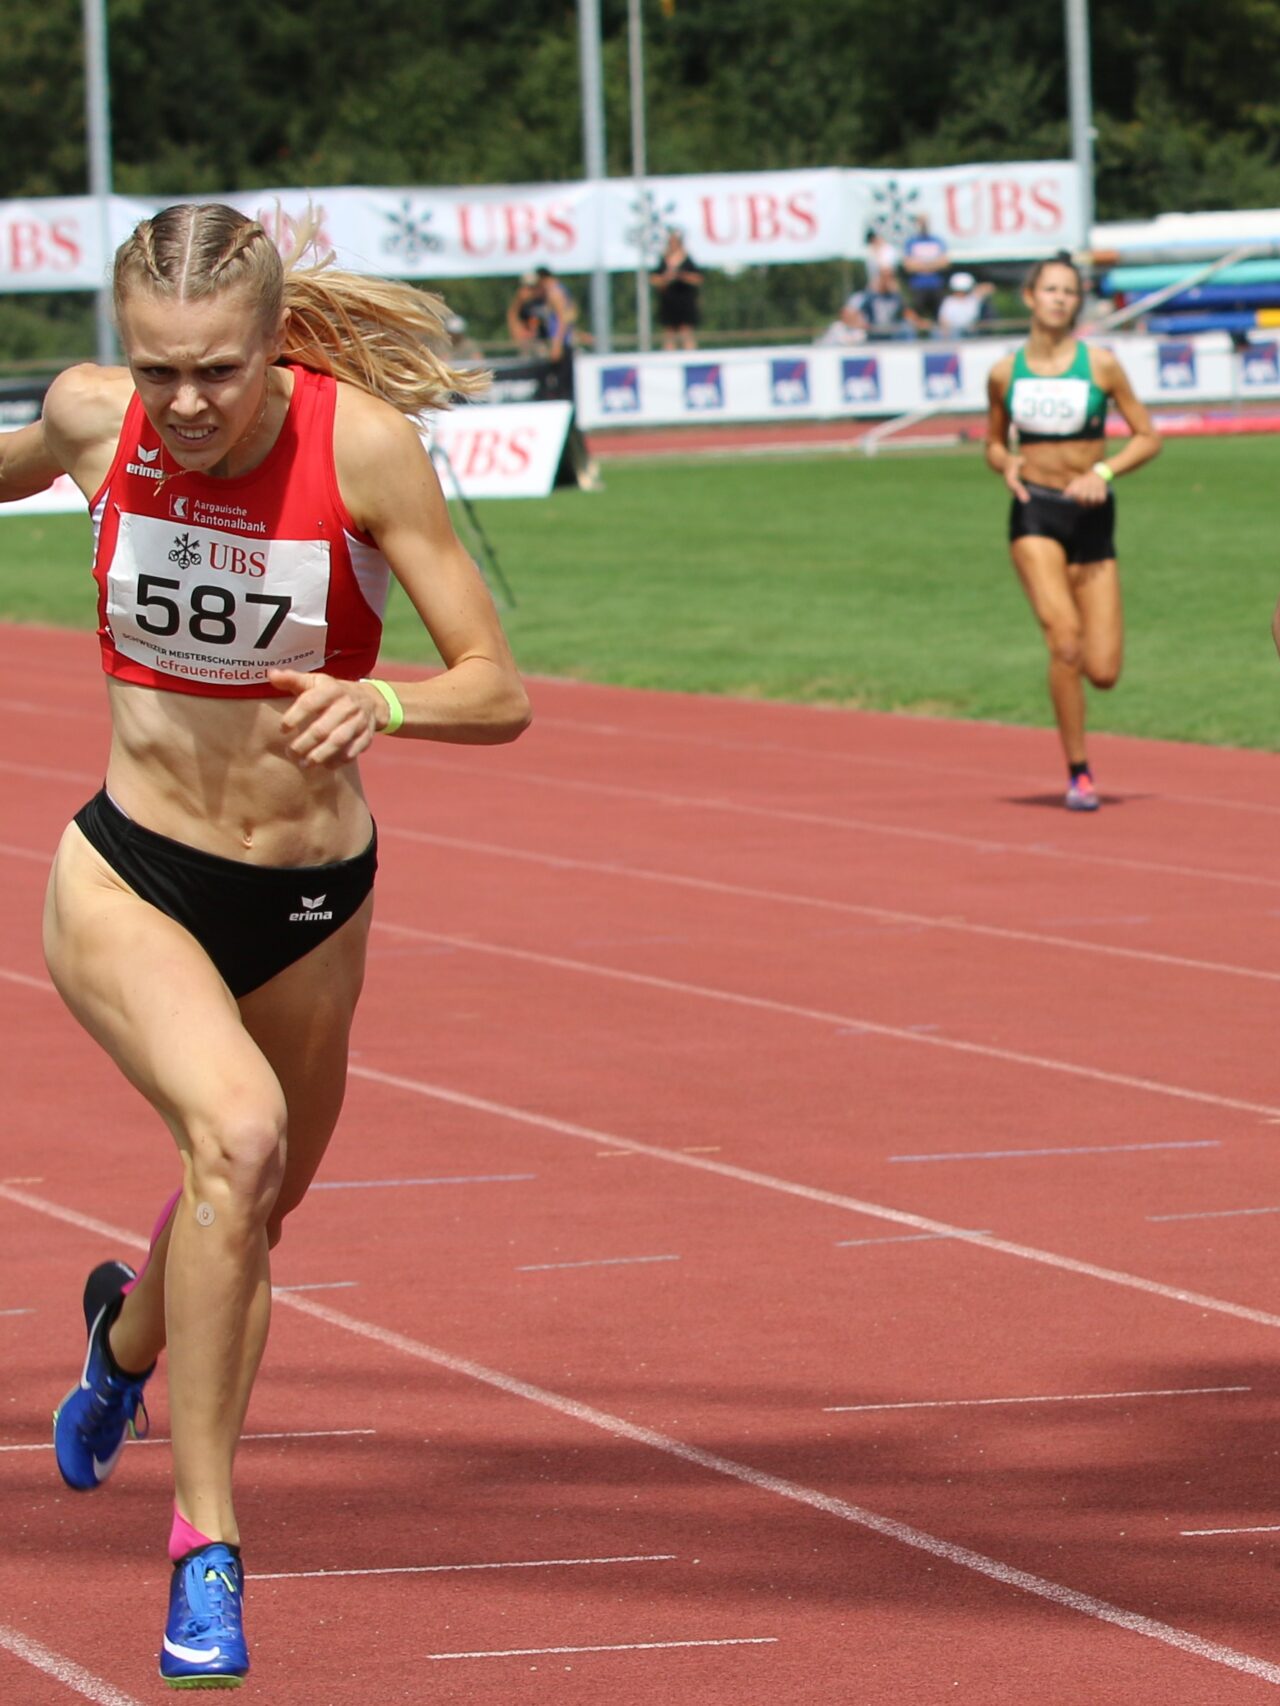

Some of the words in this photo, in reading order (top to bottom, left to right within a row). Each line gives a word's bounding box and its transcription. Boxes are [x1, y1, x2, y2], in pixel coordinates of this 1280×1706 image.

[702, 190, 818, 245] UBS
[944, 179, 1064, 239] UBS
[457, 203, 577, 257] UBS
[9, 217, 83, 274] BS
[1022, 398, 1076, 419] 305
[126, 462, 163, 479] erima
[193, 512, 266, 533] Kantonalbank
[194, 500, 248, 516] Aargauische
[208, 541, 266, 578] UBS
[135, 573, 293, 651] 587
[169, 650, 255, 667] MEISTERSCHAFTEN
[288, 910, 333, 921] erima
